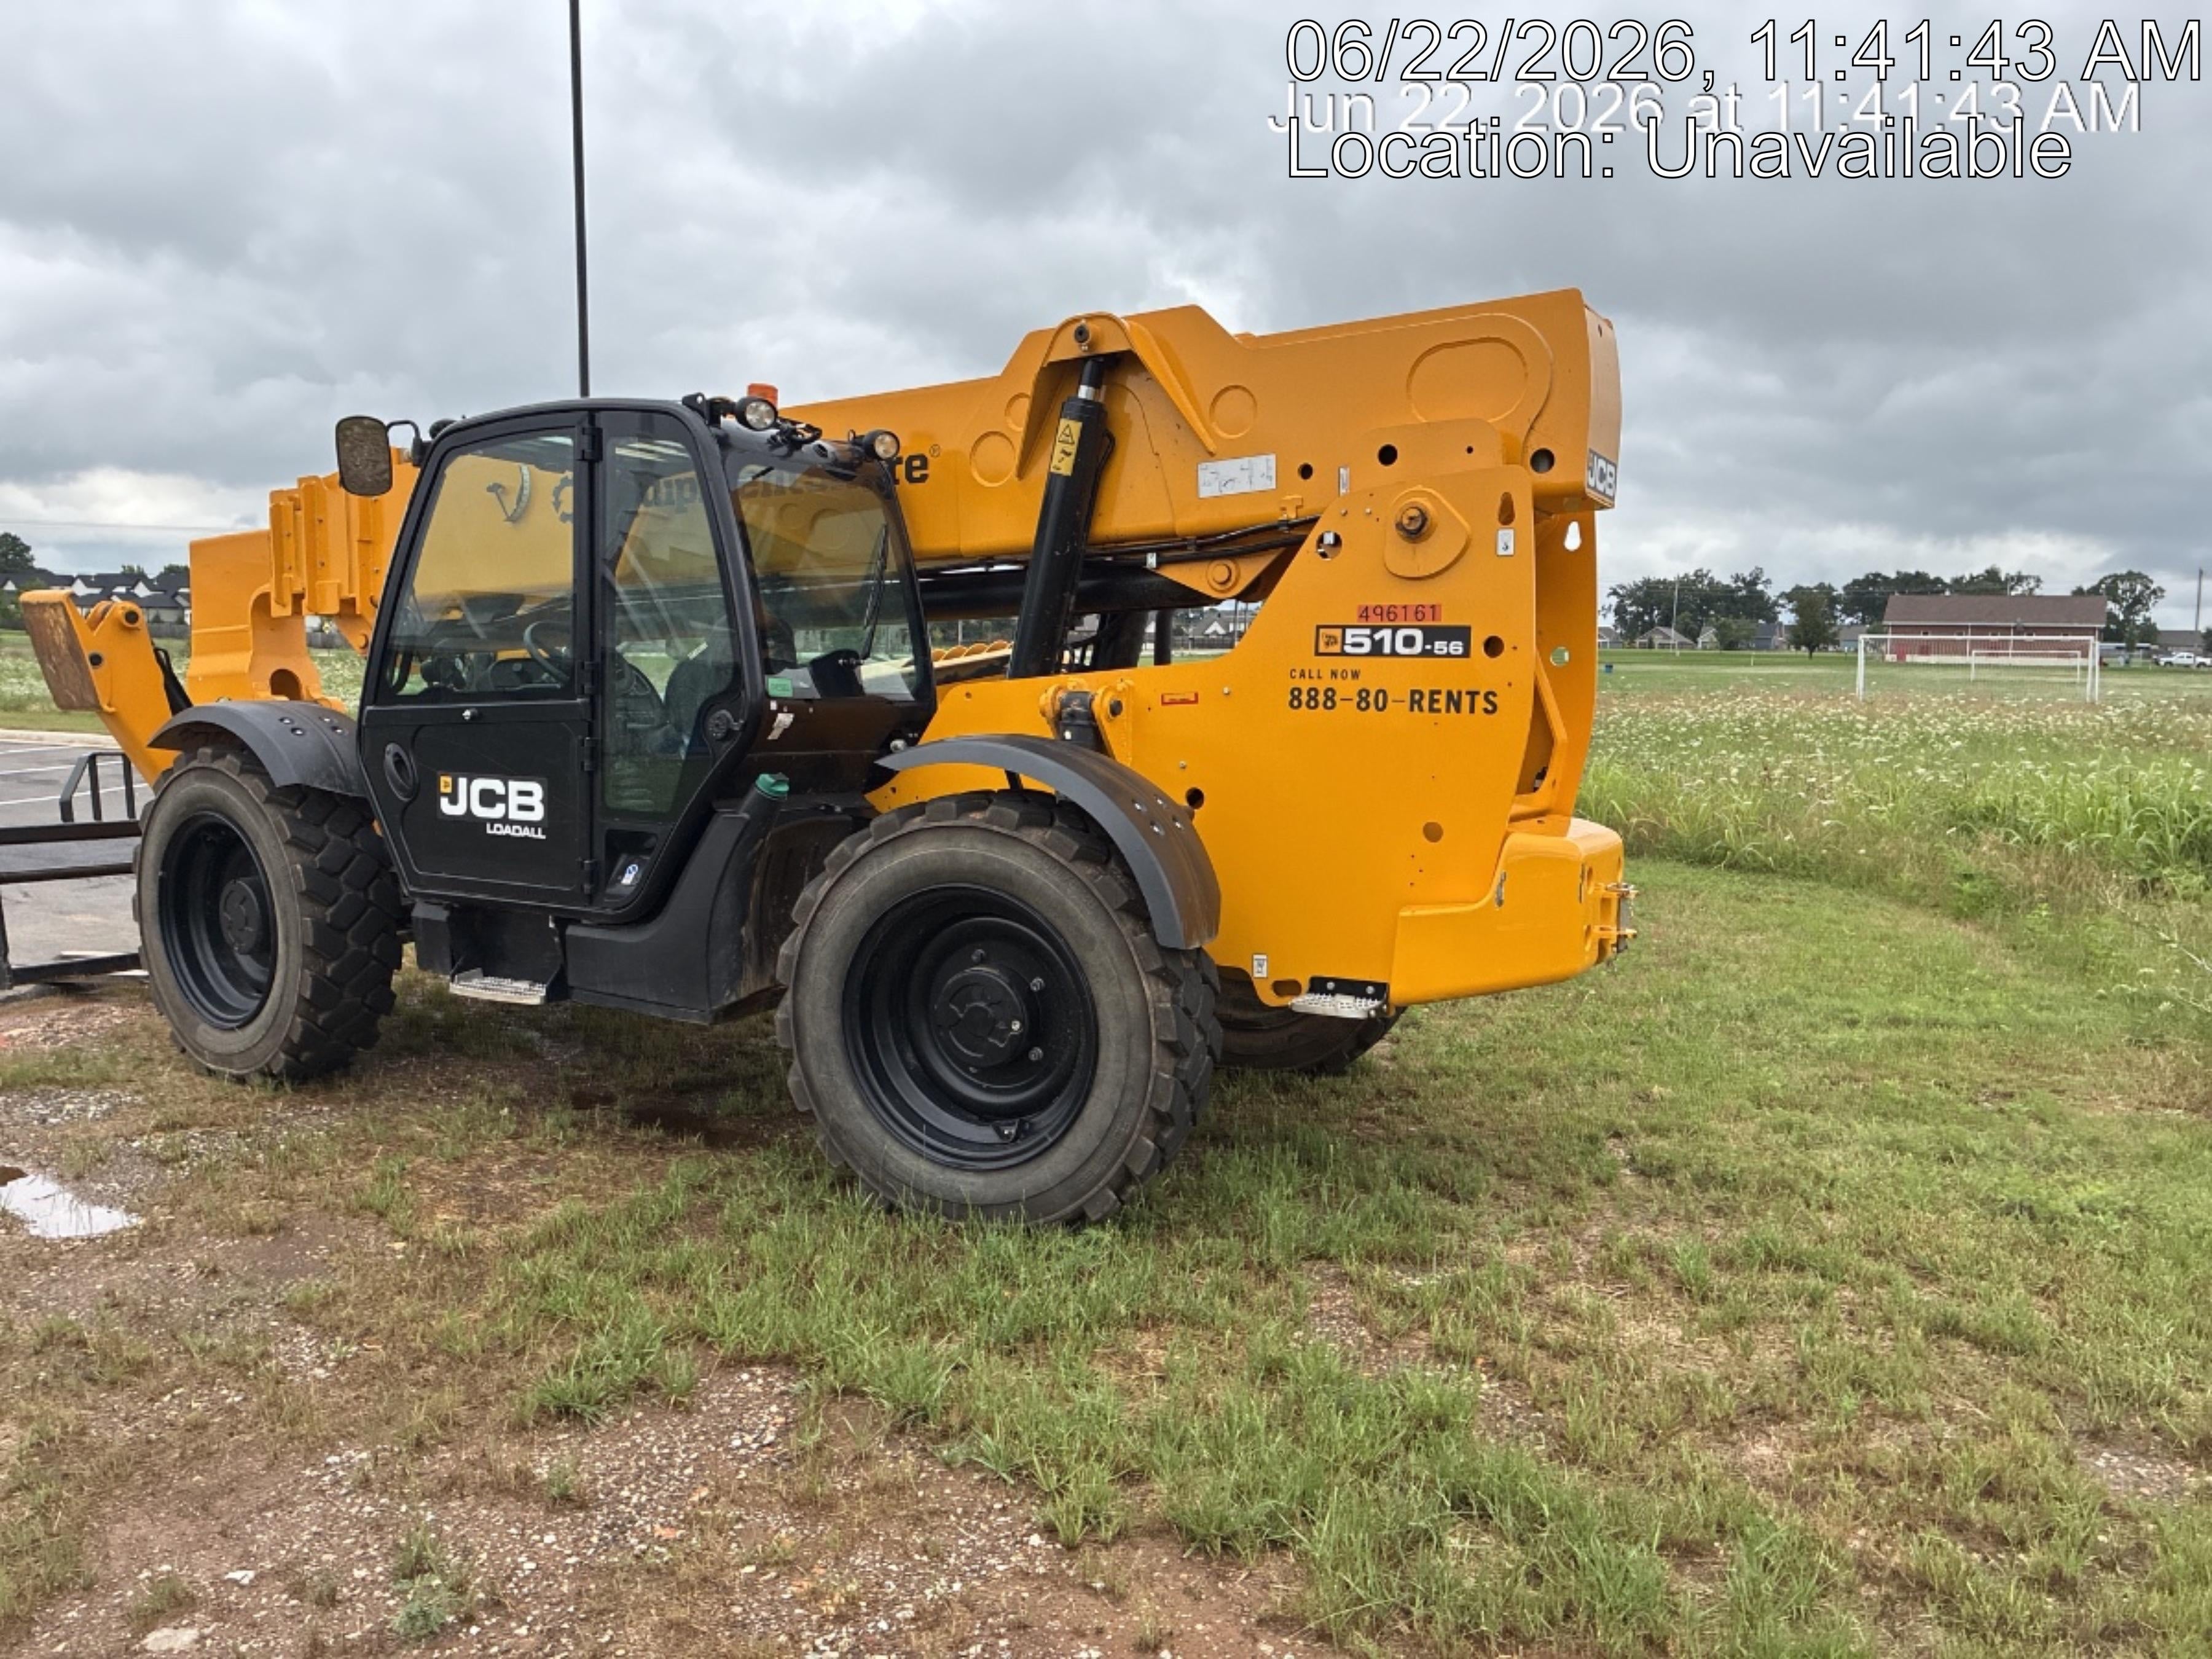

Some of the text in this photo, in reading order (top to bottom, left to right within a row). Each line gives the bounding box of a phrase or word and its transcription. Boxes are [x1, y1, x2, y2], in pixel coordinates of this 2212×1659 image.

[1587, 452, 1616, 498] JCB
[1358, 605, 1438, 622] 496161
[1289, 669, 1361, 680] CALL NOW
[439, 776, 544, 822] JCB
[486, 822, 546, 840] LOADALL
